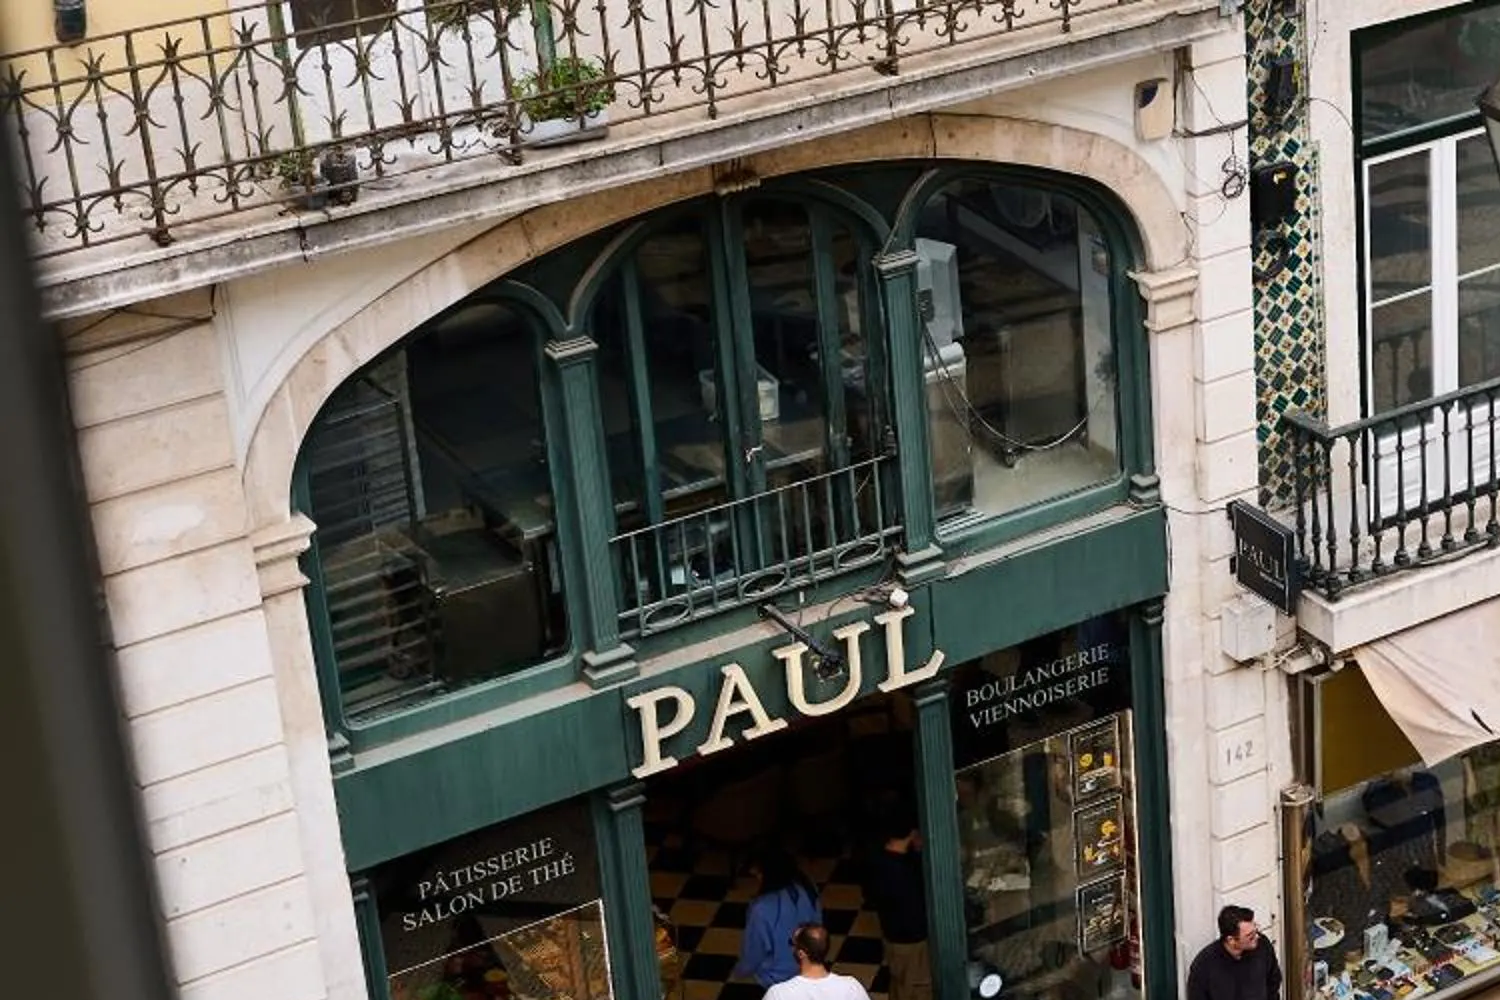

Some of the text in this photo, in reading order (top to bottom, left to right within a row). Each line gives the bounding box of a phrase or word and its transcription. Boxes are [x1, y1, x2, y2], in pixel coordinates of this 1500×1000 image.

[1239, 537, 1284, 583] PAUL
[626, 606, 945, 779] PAUL
[966, 643, 1109, 707] BOULANGERIE
[970, 667, 1109, 728] VIENNOISERIE
[1226, 740, 1254, 765] 142
[402, 852, 576, 932] SALON DE THÉ
[418, 836, 553, 900] PÂTISSERIE
